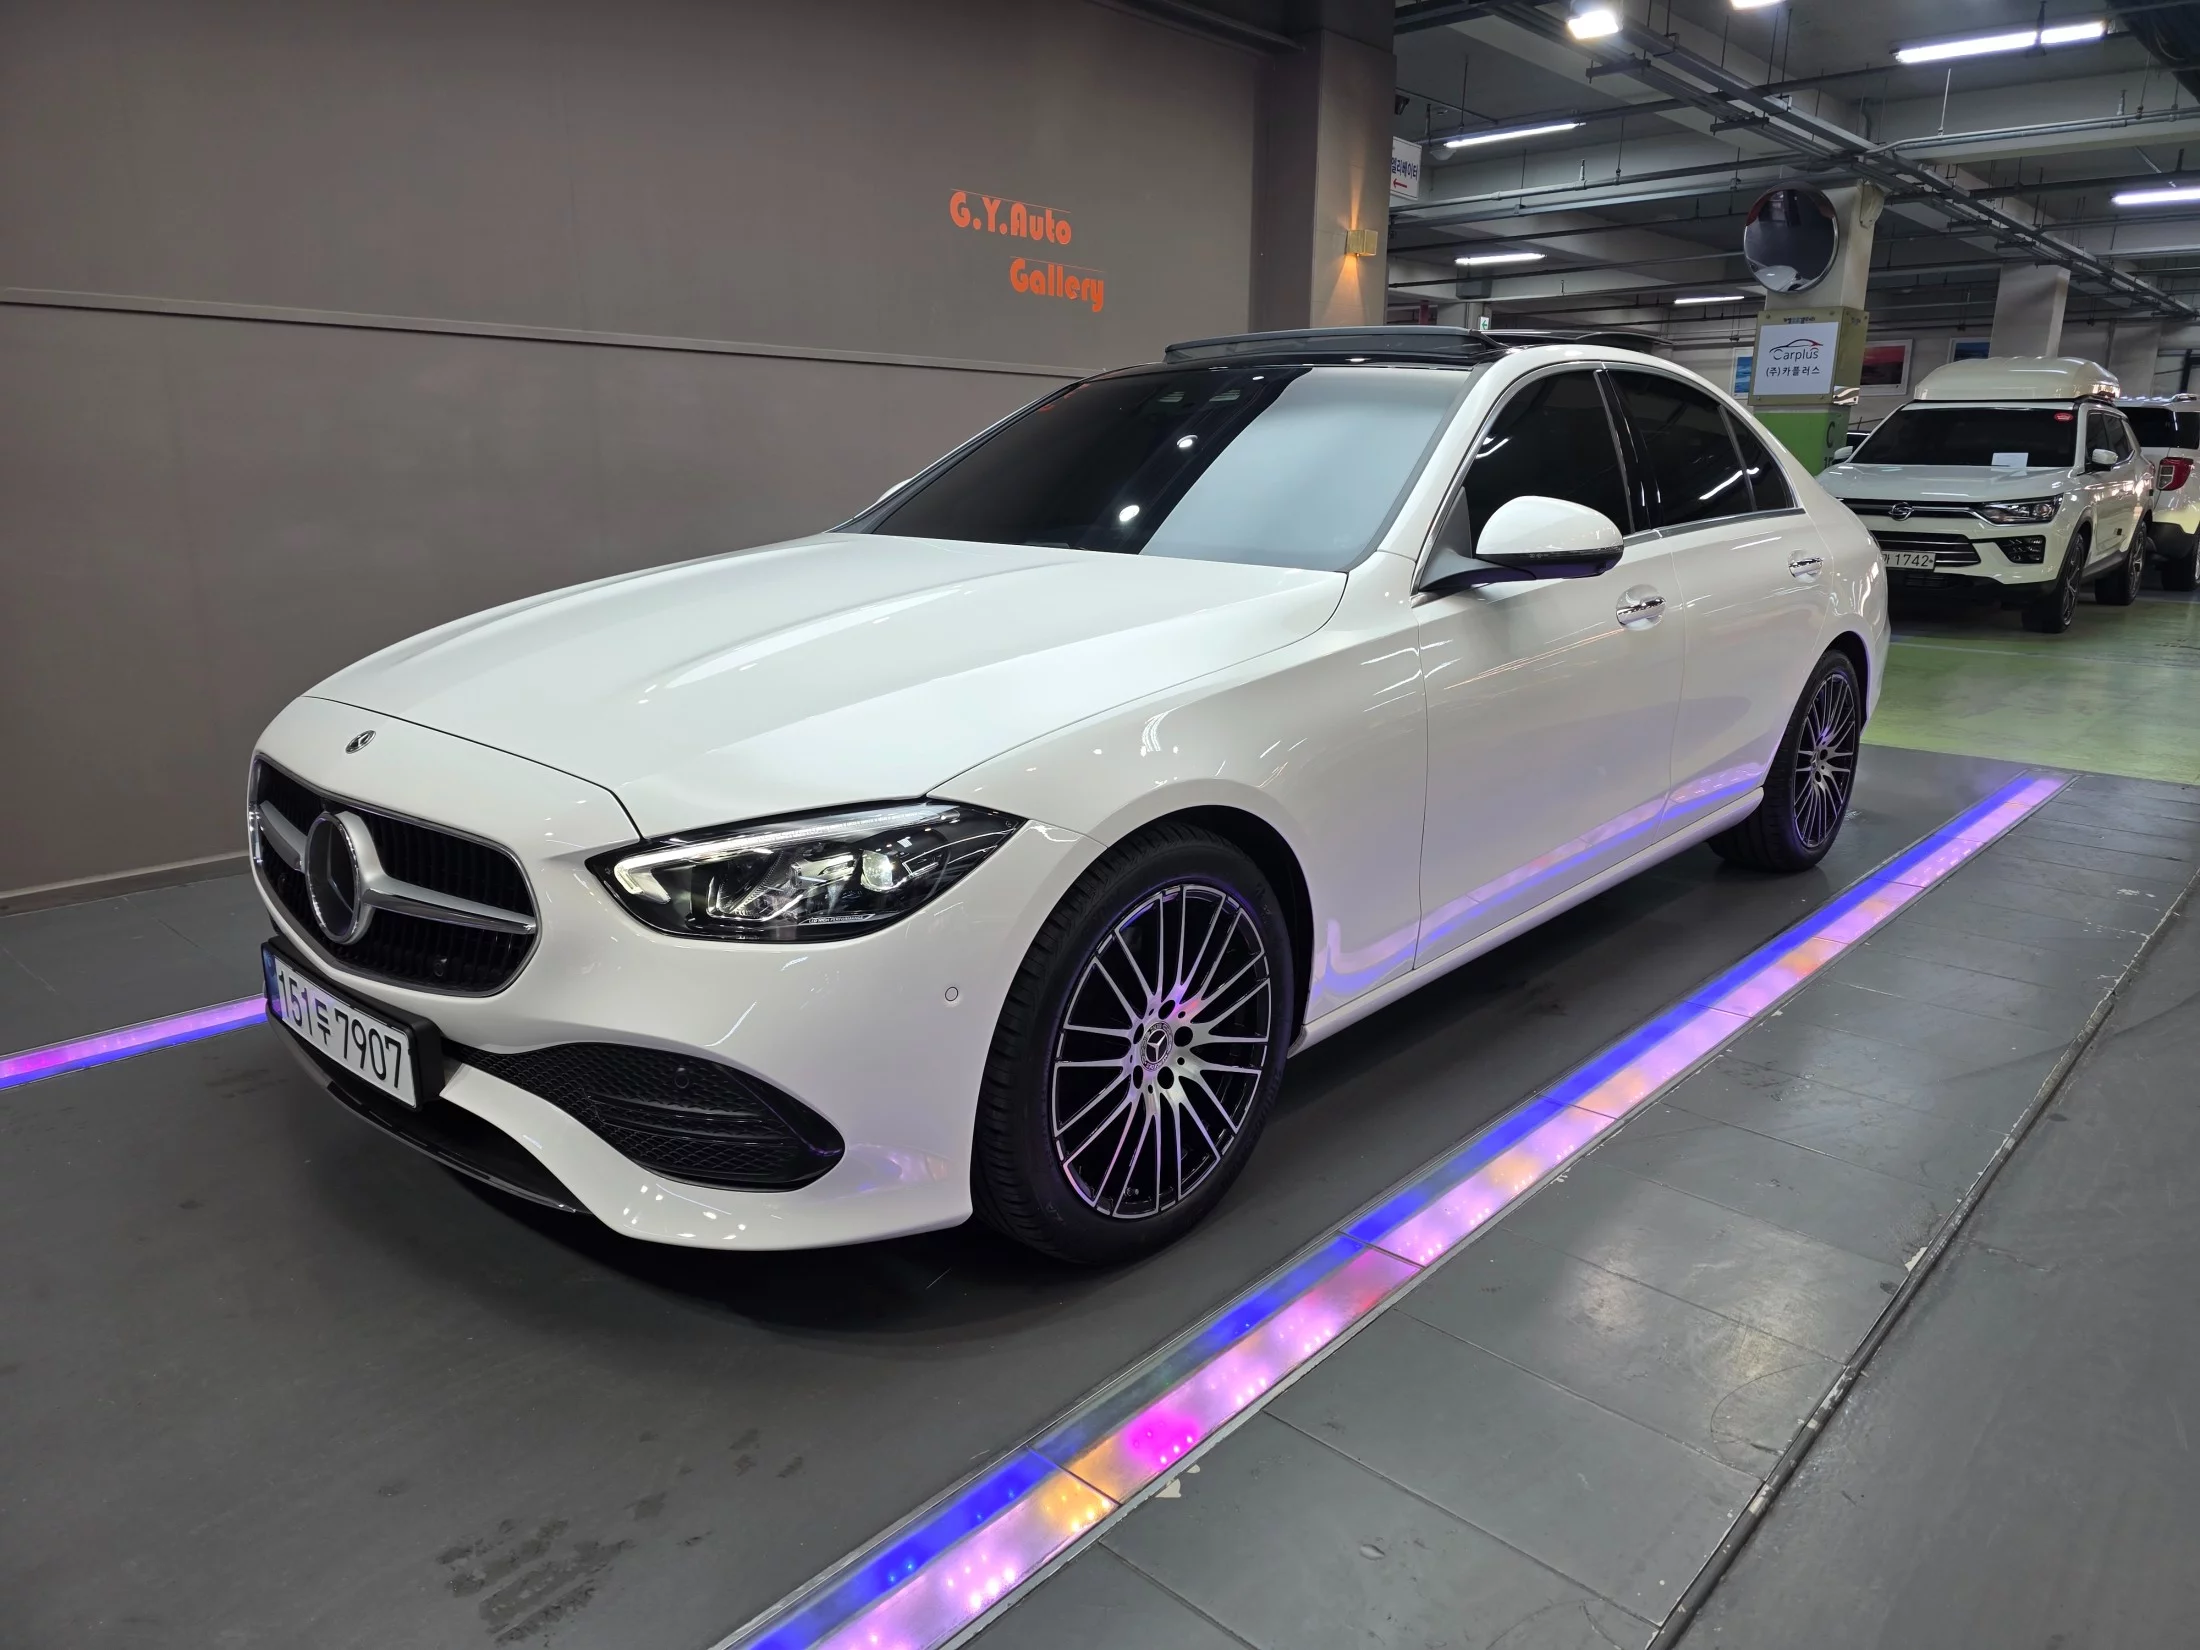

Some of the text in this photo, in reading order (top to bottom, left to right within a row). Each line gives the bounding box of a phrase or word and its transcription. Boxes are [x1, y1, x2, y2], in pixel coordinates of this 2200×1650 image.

[950, 191, 1072, 245] G.Y.Auto
[1010, 258, 1104, 313] Gallery
[1773, 348, 1819, 362] Carplus
[1894, 554, 1930, 567] 1742
